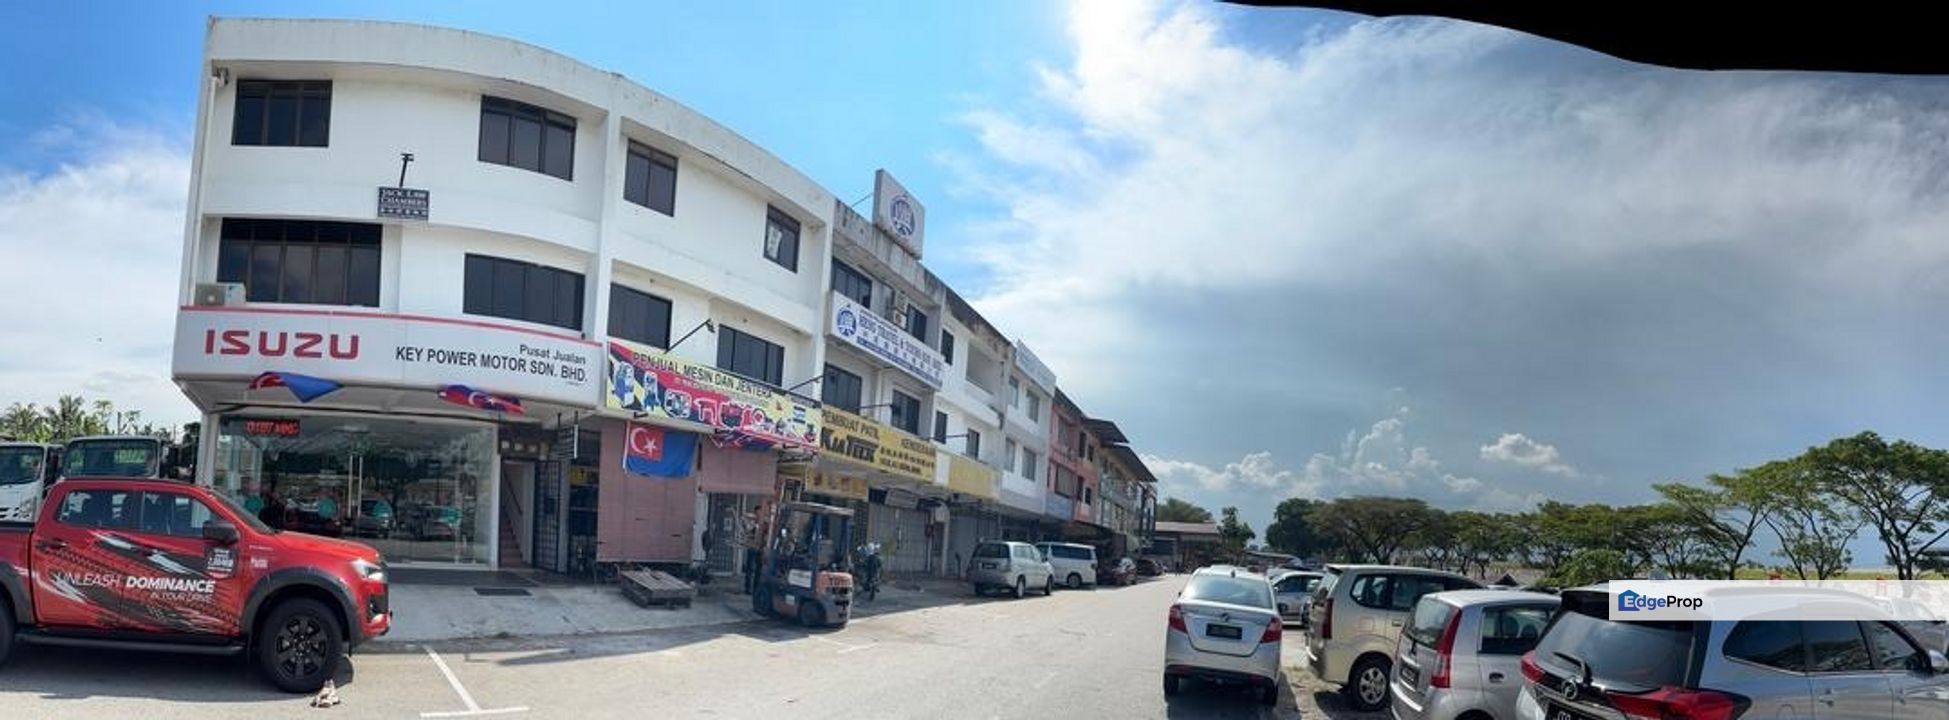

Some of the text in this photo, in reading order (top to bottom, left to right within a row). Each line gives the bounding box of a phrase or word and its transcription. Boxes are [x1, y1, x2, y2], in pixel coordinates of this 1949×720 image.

[205, 329, 359, 360] ISUZU
[519, 344, 586, 364] Pusat Jualan
[395, 346, 588, 382] KEY POWER MOTOR SDN. BHD.
[633, 352, 680, 375] PENJUAL
[684, 364, 714, 382] MESIN
[714, 373, 734, 389] DAN
[57, 571, 216, 593] UNLEASH DOMINANCE
